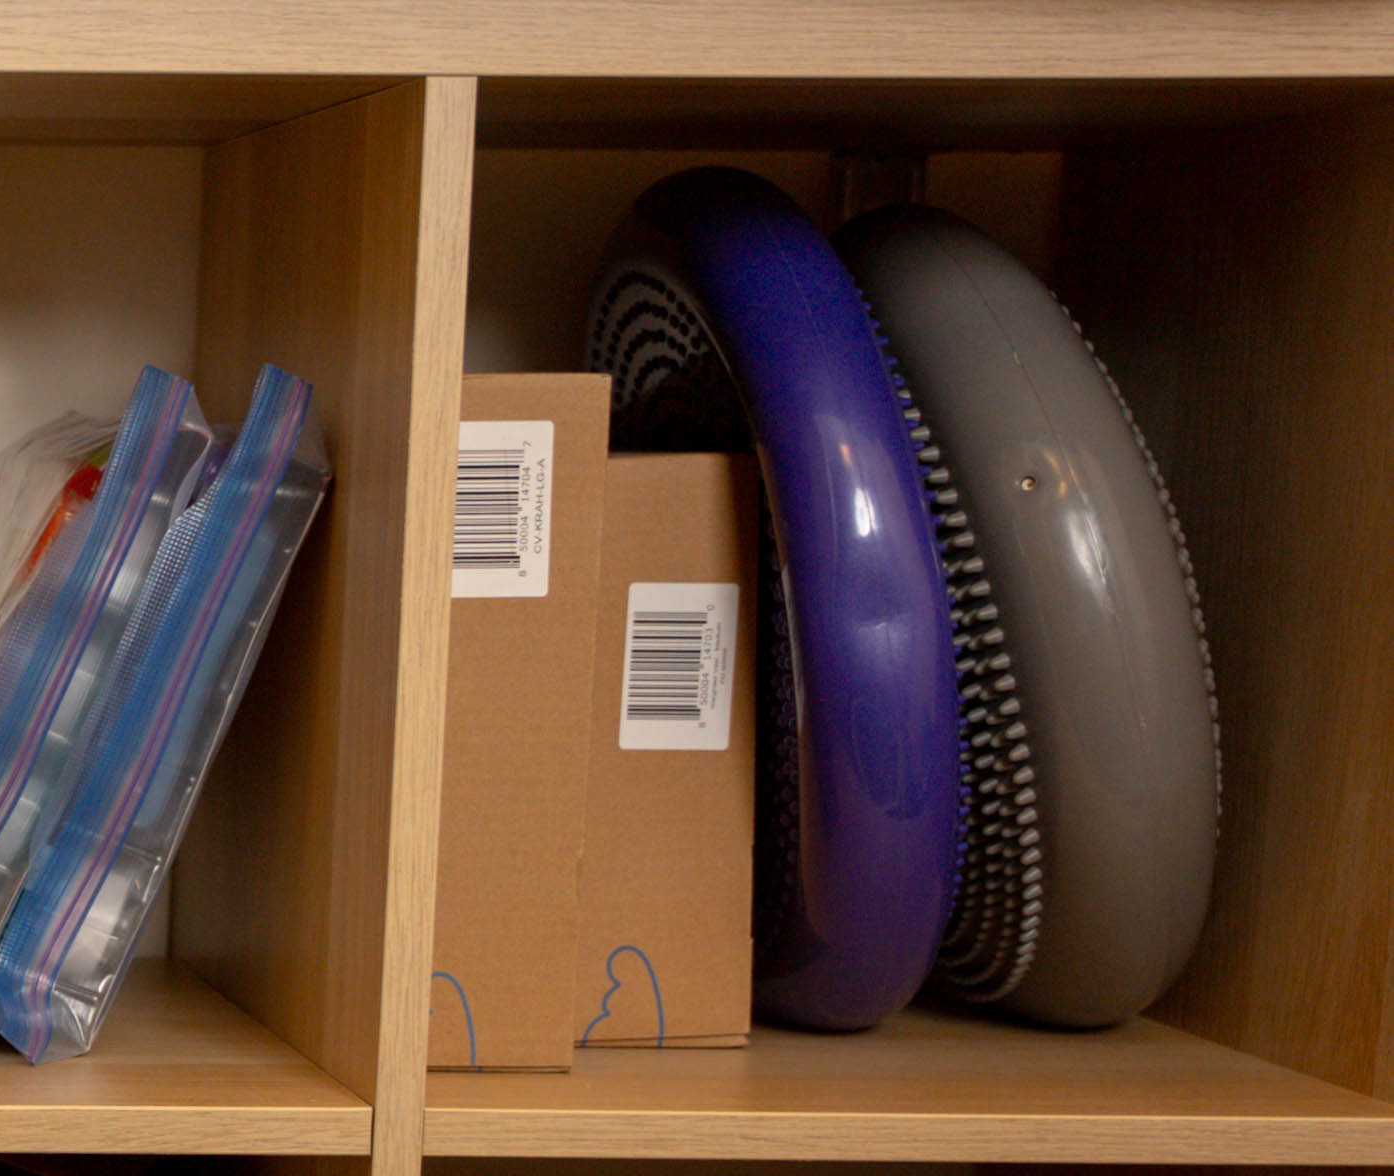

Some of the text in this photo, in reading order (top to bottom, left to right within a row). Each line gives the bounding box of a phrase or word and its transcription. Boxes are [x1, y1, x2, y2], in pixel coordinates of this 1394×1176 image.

[521, 467, 530, 502] 14704
[519, 516, 529, 552] 50004
[700, 673, 710, 706] 50004
